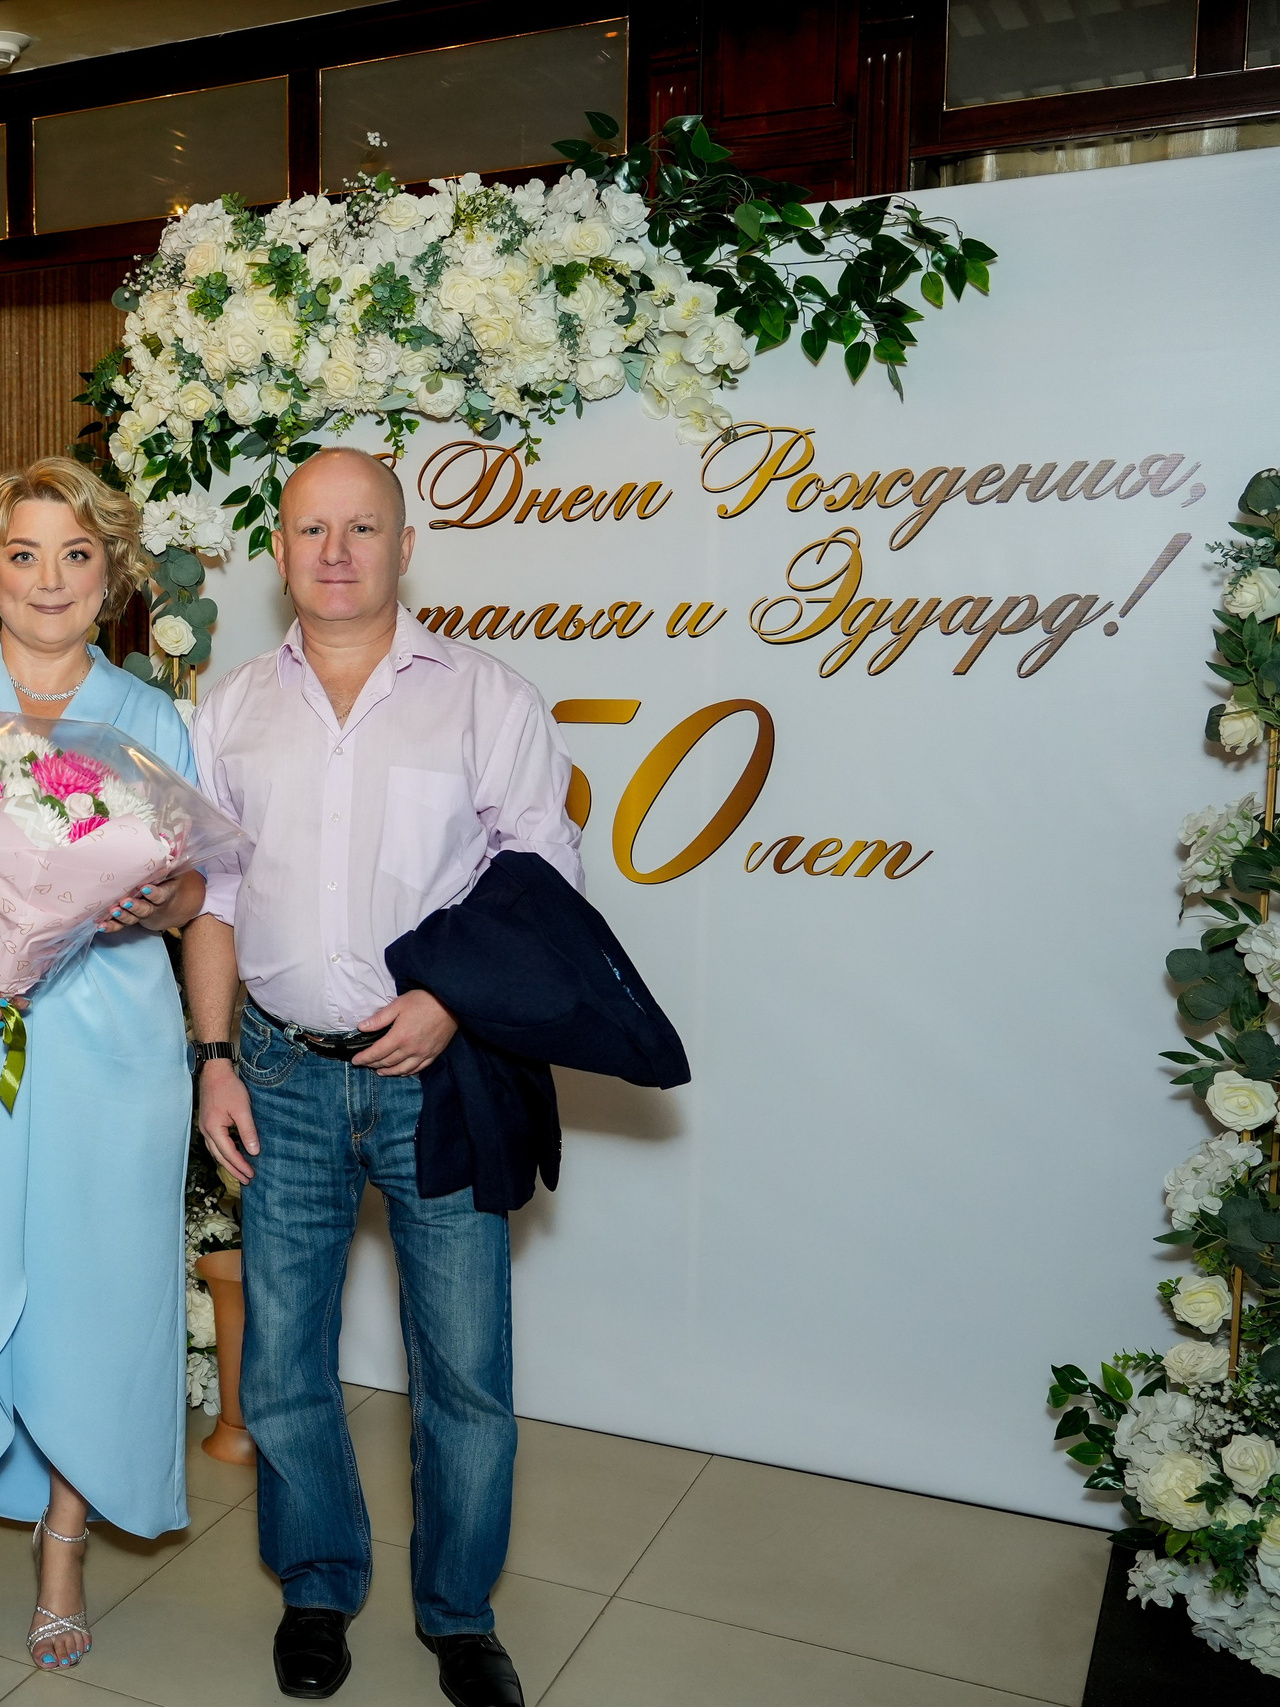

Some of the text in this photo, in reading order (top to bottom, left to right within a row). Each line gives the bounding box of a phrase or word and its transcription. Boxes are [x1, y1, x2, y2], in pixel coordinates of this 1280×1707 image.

[418, 421, 1206, 551] Днем Рождения,
[407, 526, 1192, 679] талья и Эдуард!
[744, 829, 934, 880] лет
